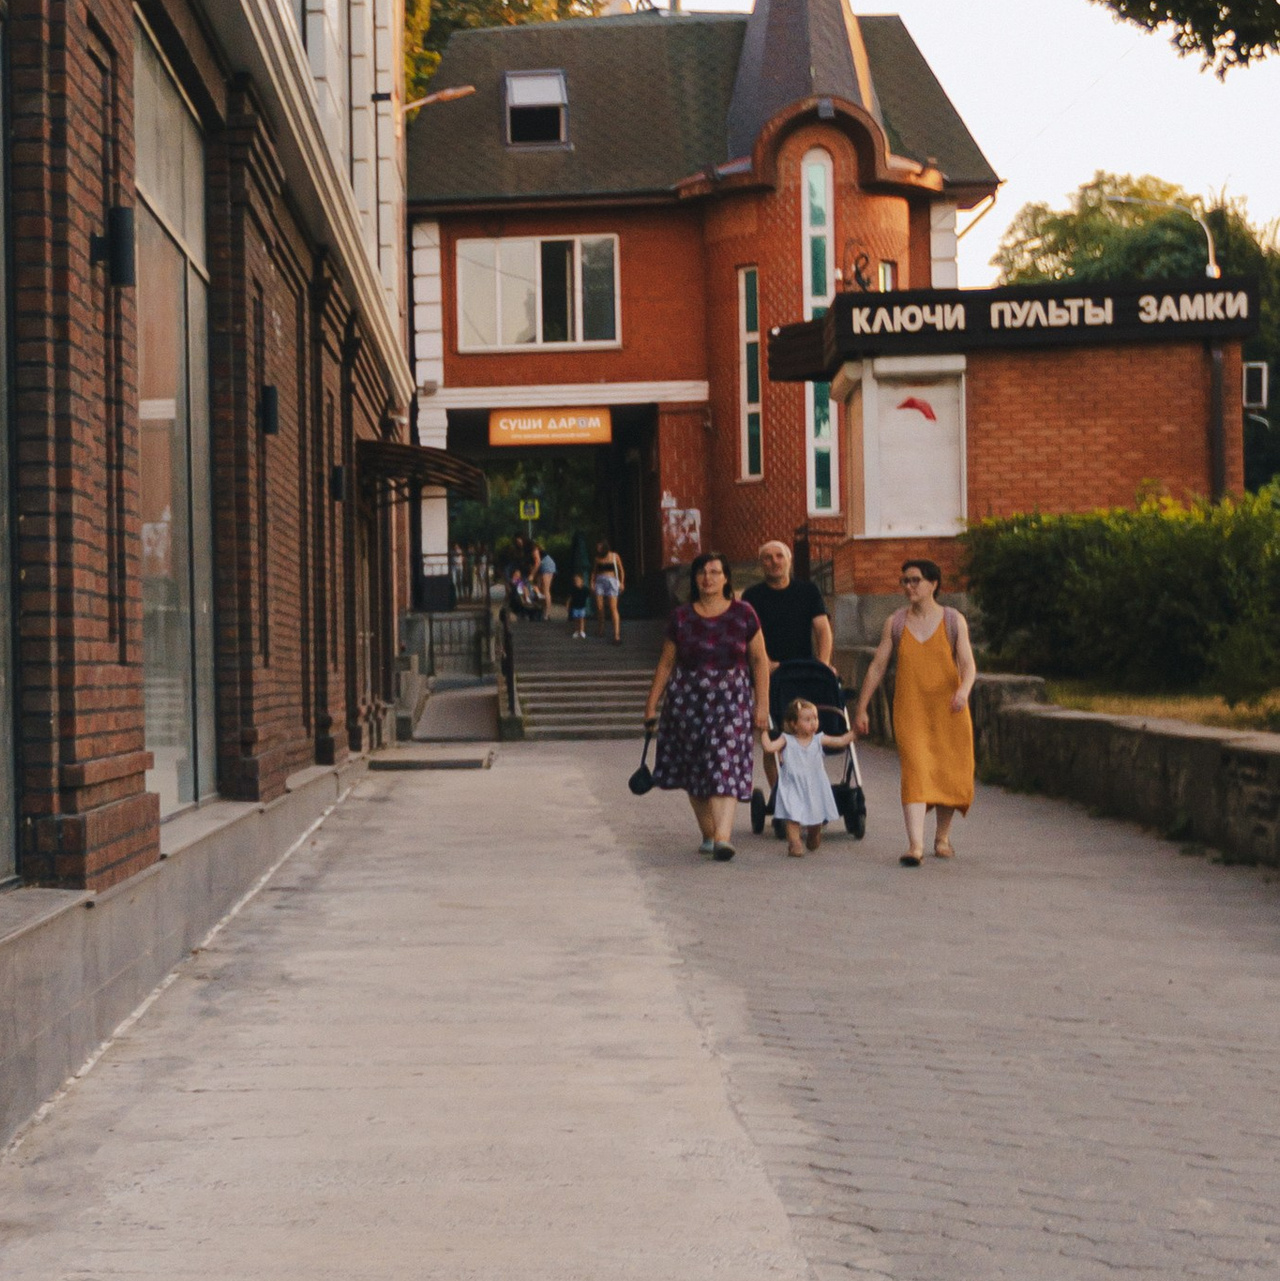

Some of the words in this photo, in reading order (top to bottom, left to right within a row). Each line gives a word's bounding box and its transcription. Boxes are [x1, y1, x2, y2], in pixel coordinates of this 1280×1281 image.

[852, 303, 966, 334] КЛЮЧИ
[990, 297, 1114, 328] ПУЛЬТЫ
[1138, 290, 1249, 324] ЗАМКИ
[499, 418, 543, 431] СУШИ
